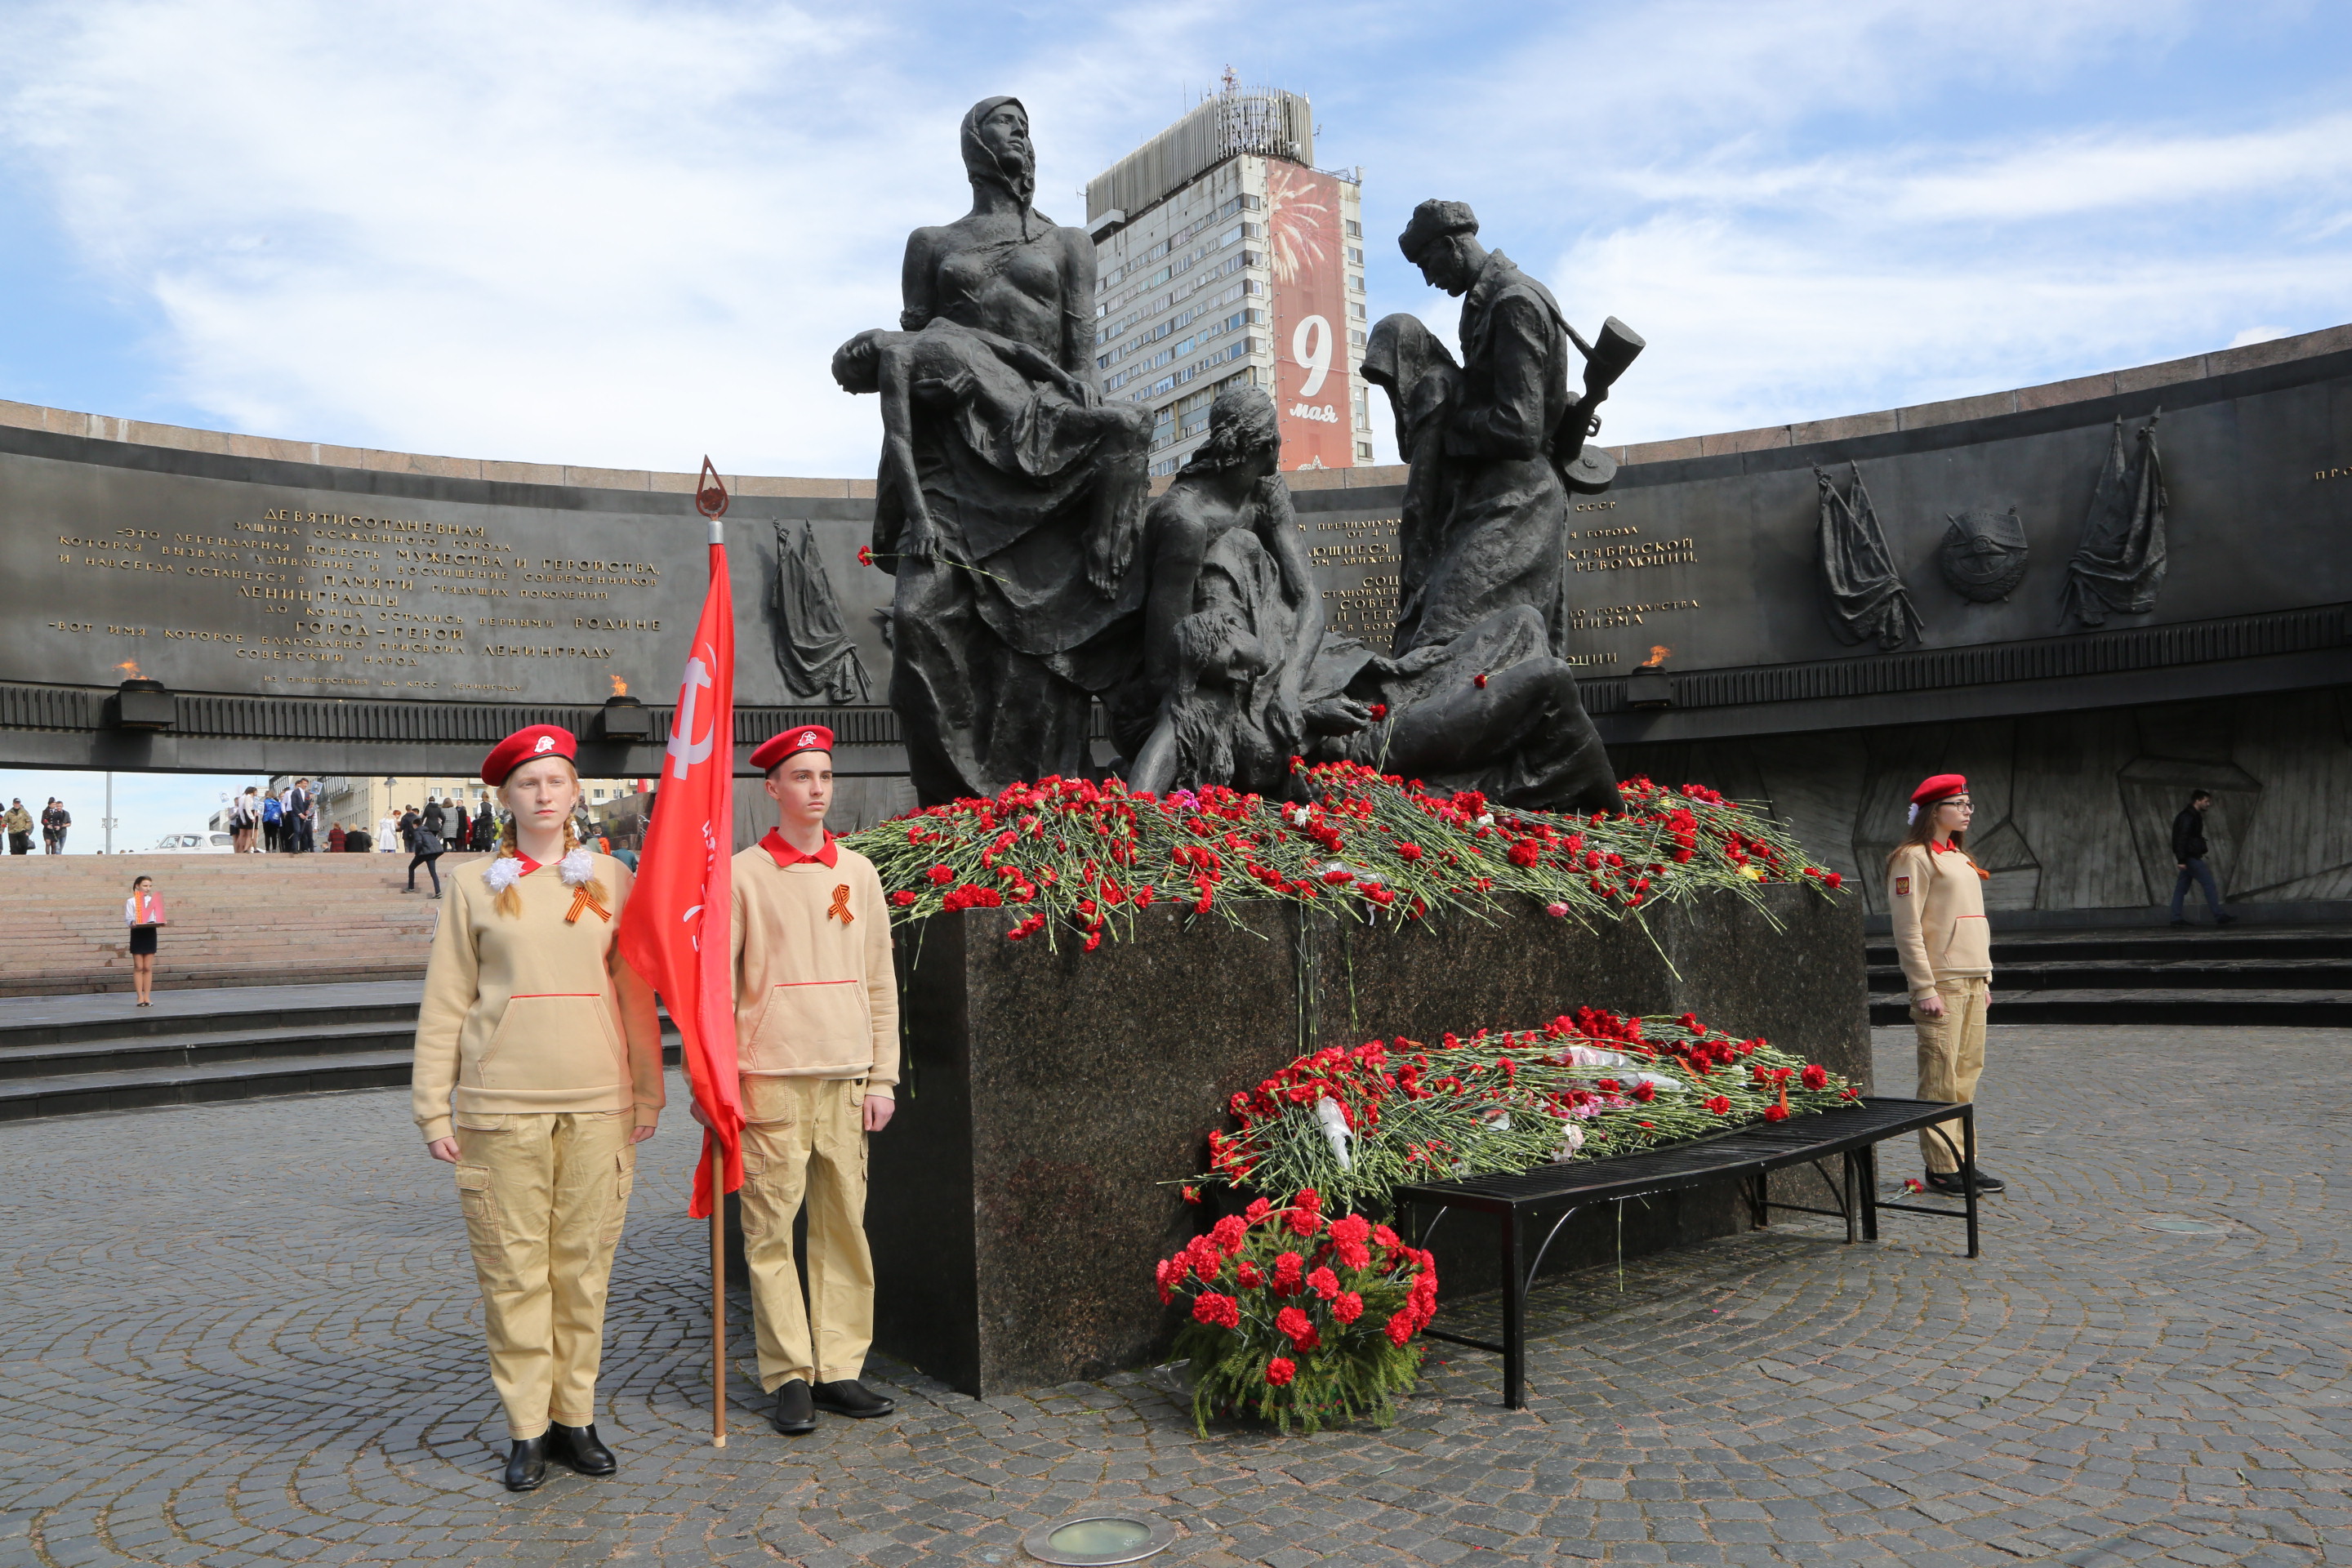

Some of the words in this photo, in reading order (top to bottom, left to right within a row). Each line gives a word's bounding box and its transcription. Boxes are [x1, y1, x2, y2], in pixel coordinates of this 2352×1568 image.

[1292, 315, 1332, 397] 9
[1290, 403, 1339, 423] мая
[1575, 501, 1616, 510] СССР
[263, 509, 484, 537] ДЕВЯТИСОТДНЕВНАЯ
[1588, 526, 1638, 537] ГОРОДА
[234, 522, 299, 535] ЗАЩИТА
[453, 541, 510, 551] ГОРОДА
[60, 536, 142, 551] КОТОРАЯ
[163, 546, 238, 560] ВЫЗВАЛА
[256, 555, 353, 569] УДИВЛЕНИЕ
[398, 566, 506, 579] ВОСХИЩЕНИЕ
[525, 574, 657, 586] СОВРЕМЕННИКОВ
[176, 533, 291, 550] ЛЕГЕНДАРНАЯ
[306, 546, 380, 559] ПОВЕСТЬ
[399, 550, 502, 566] МУЖЕСТВА
[517, 559, 528, 568] И
[543, 559, 661, 575] ГЕРОЙСТВА,
[1577, 551, 1698, 572] РЕВОЛЮЦИИ,
[60, 555, 70, 563] И
[85, 558, 173, 572] НАВСЕГДА
[186, 567, 286, 581] ОСТАНЕТСЯ
[324, 575, 414, 590] ПАМЯТИ
[431, 585, 510, 596] ГРЯДУЩИХ
[519, 590, 608, 599] ПОКОЛЕНИЙ
[238, 586, 399, 606] ЛЕНИНГРАДЦЫ
[1338, 612, 1348, 621] И
[1597, 600, 1700, 615] ГОСУДАРСТВА,
[305, 608, 362, 618] КОНЦА
[379, 613, 463, 623] ОСТАЛИСЬ
[479, 617, 555, 627] ВЕРНЫМИ
[576, 618, 661, 630] РОДИНЕ
[109, 626, 147, 636] ИМЯ
[164, 630, 243, 642] КОТОРОЕ
[261, 636, 364, 649] БЛАГОДАРНО
[379, 643, 463, 653] ПРИСВОИЛ
[483, 644, 613, 659] ЛЕНИНГРАДУ
[235, 649, 344, 662] СОВЕТСКИЙ
[364, 656, 418, 666] НАРОД
